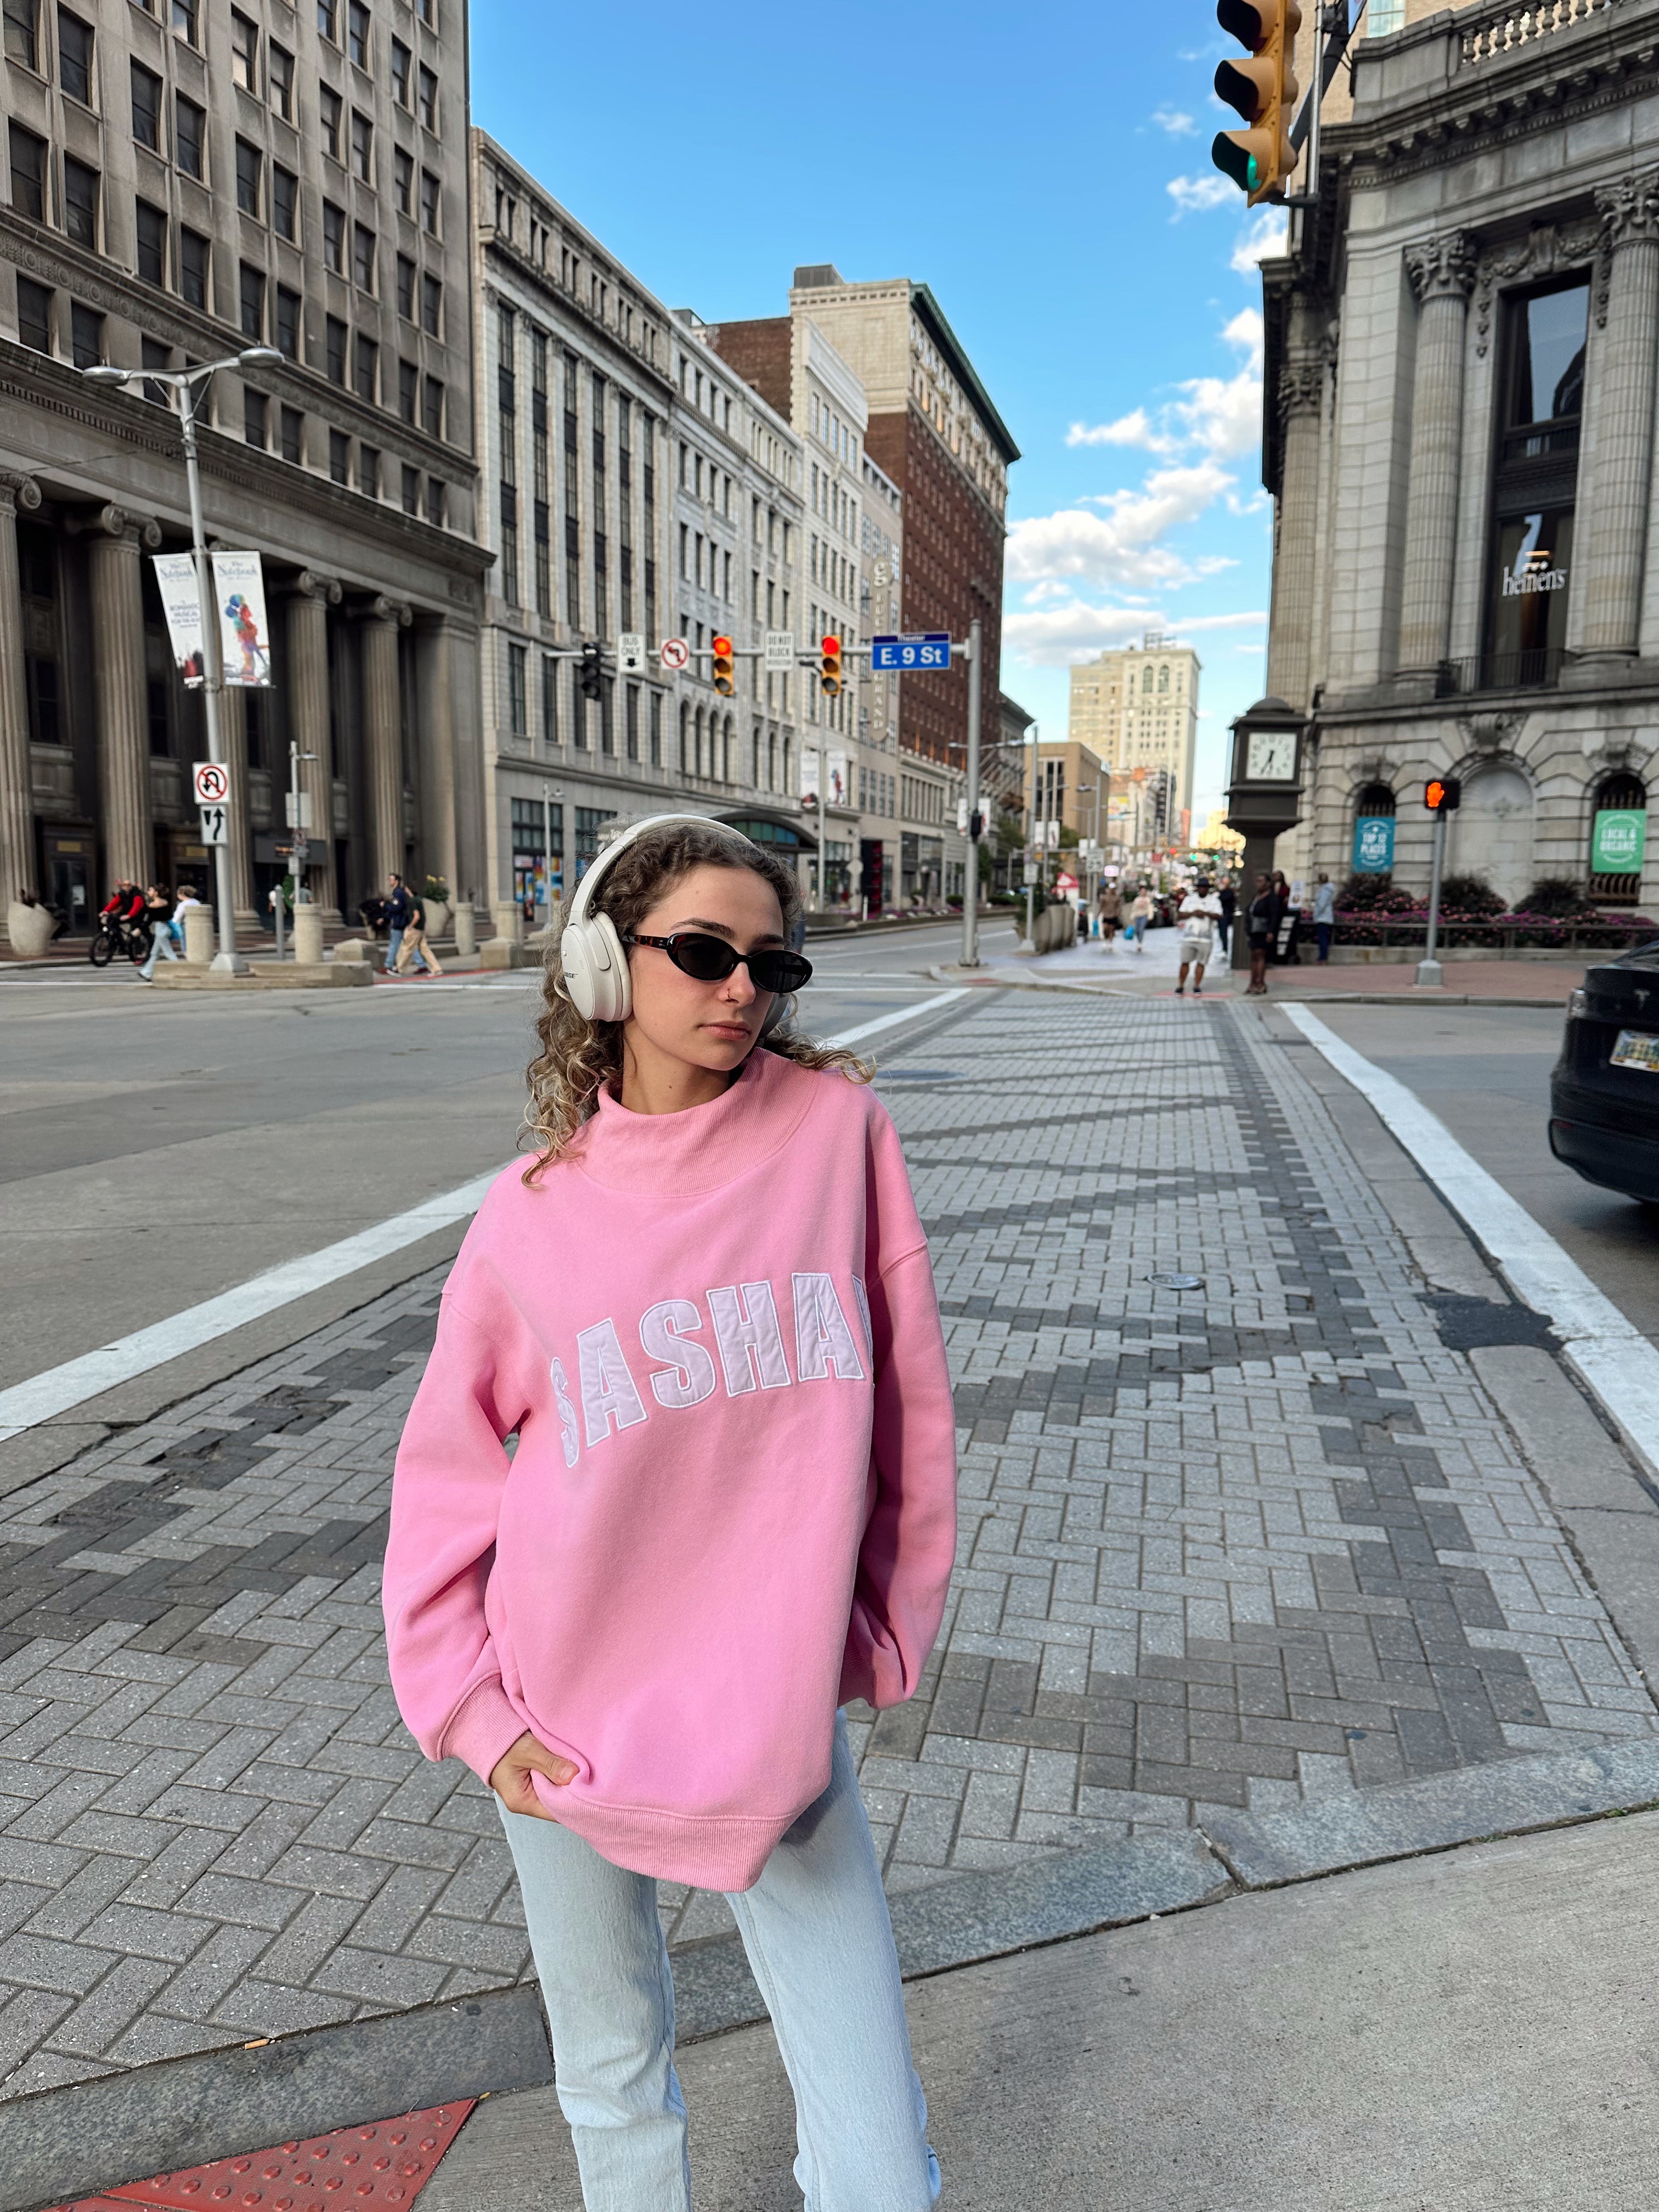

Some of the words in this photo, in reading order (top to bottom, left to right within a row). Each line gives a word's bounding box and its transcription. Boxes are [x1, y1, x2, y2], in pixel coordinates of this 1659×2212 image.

[623, 636, 639, 646] BUS
[621, 647, 640, 657] ONLY
[881, 647, 898, 665] E.
[901, 646, 915, 665] 9
[920, 646, 943, 665] St
[1363, 832, 1376, 844] TOP
[550, 1272, 874, 1468] SASHA
